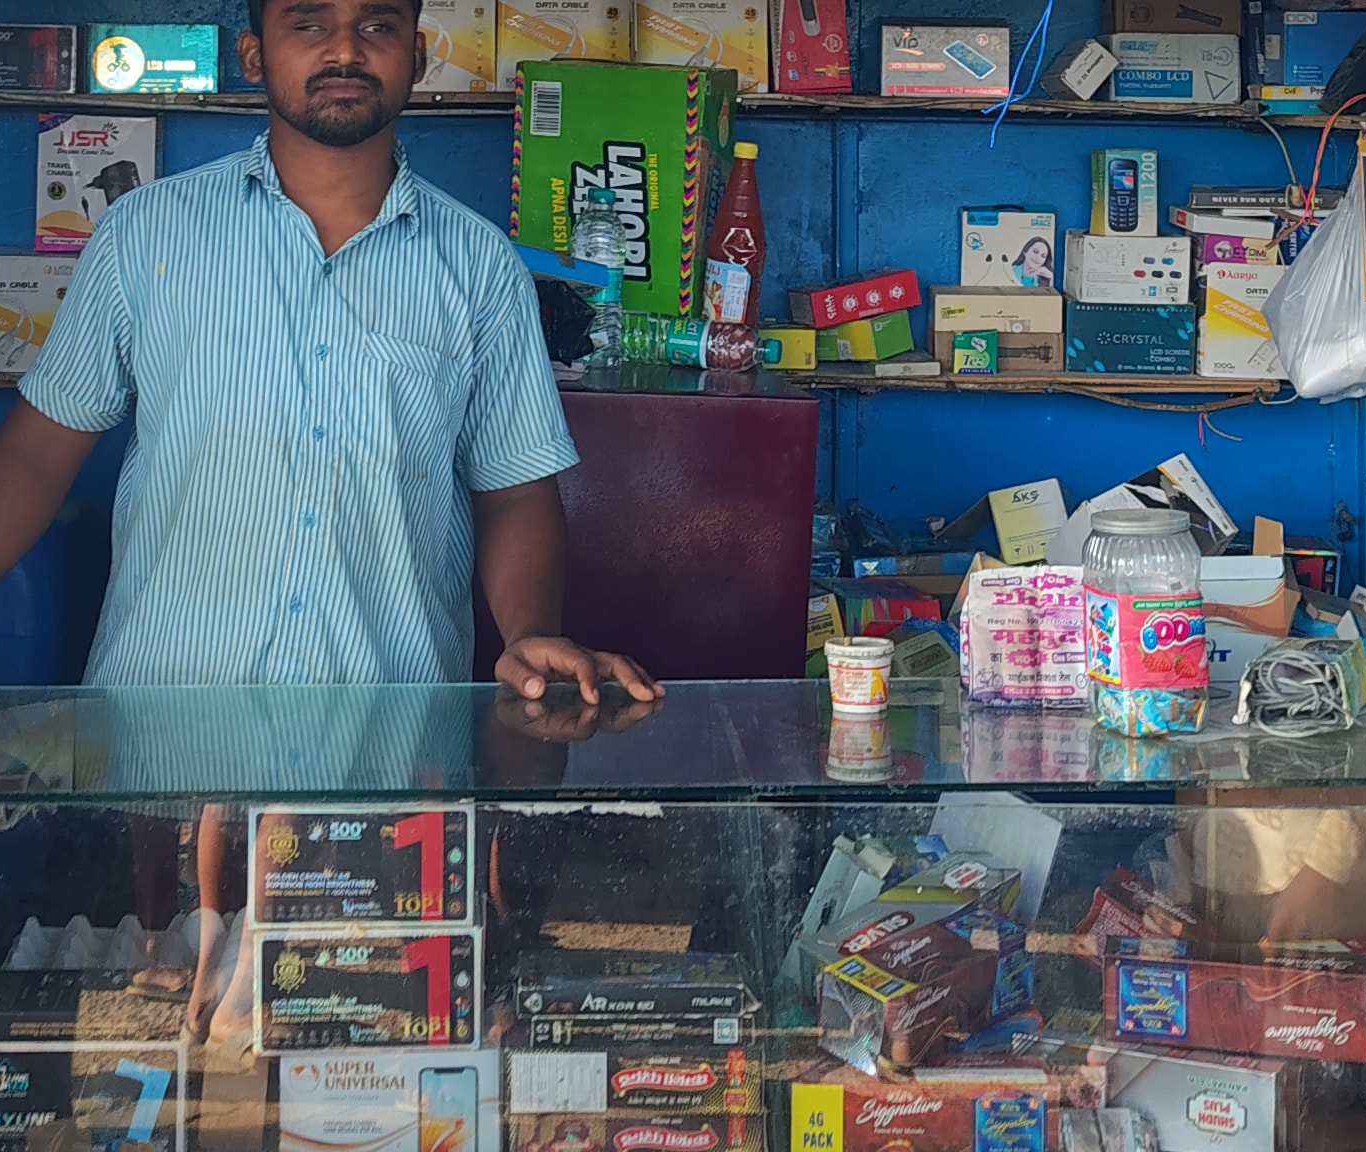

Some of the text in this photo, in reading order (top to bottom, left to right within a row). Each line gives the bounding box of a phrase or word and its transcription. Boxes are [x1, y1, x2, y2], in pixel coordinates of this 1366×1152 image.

[535, 1, 590, 9] DATA CABLE
[1118, 70, 1190, 81] COMBO LCD
[47, 162, 72, 170] TRAVEL
[1141, 151, 1157, 187] 1200
[648, 153, 660, 211] THE ORIGINAL
[1212, 196, 1238, 204] NEVER
[1239, 196, 1257, 204] RUN
[1259, 196, 1276, 204] OUT
[550, 177, 568, 244] APNA DESI
[10, 281, 39, 289] CABLE
[1222, 300, 1252, 317] FAST
[1112, 333, 1164, 345] CRYSTAL
[1149, 348, 1191, 356] LCD SCREEN
[1149, 355, 1176, 363] COMBO
[324, 1060, 375, 1075] SUPER
[324, 1075, 406, 1091] UNIVERSAL
[1203, 1099, 1232, 1114] PLUS
[1197, 1112, 1235, 1129] SHUDH
[803, 1132, 833, 1148] PACK
